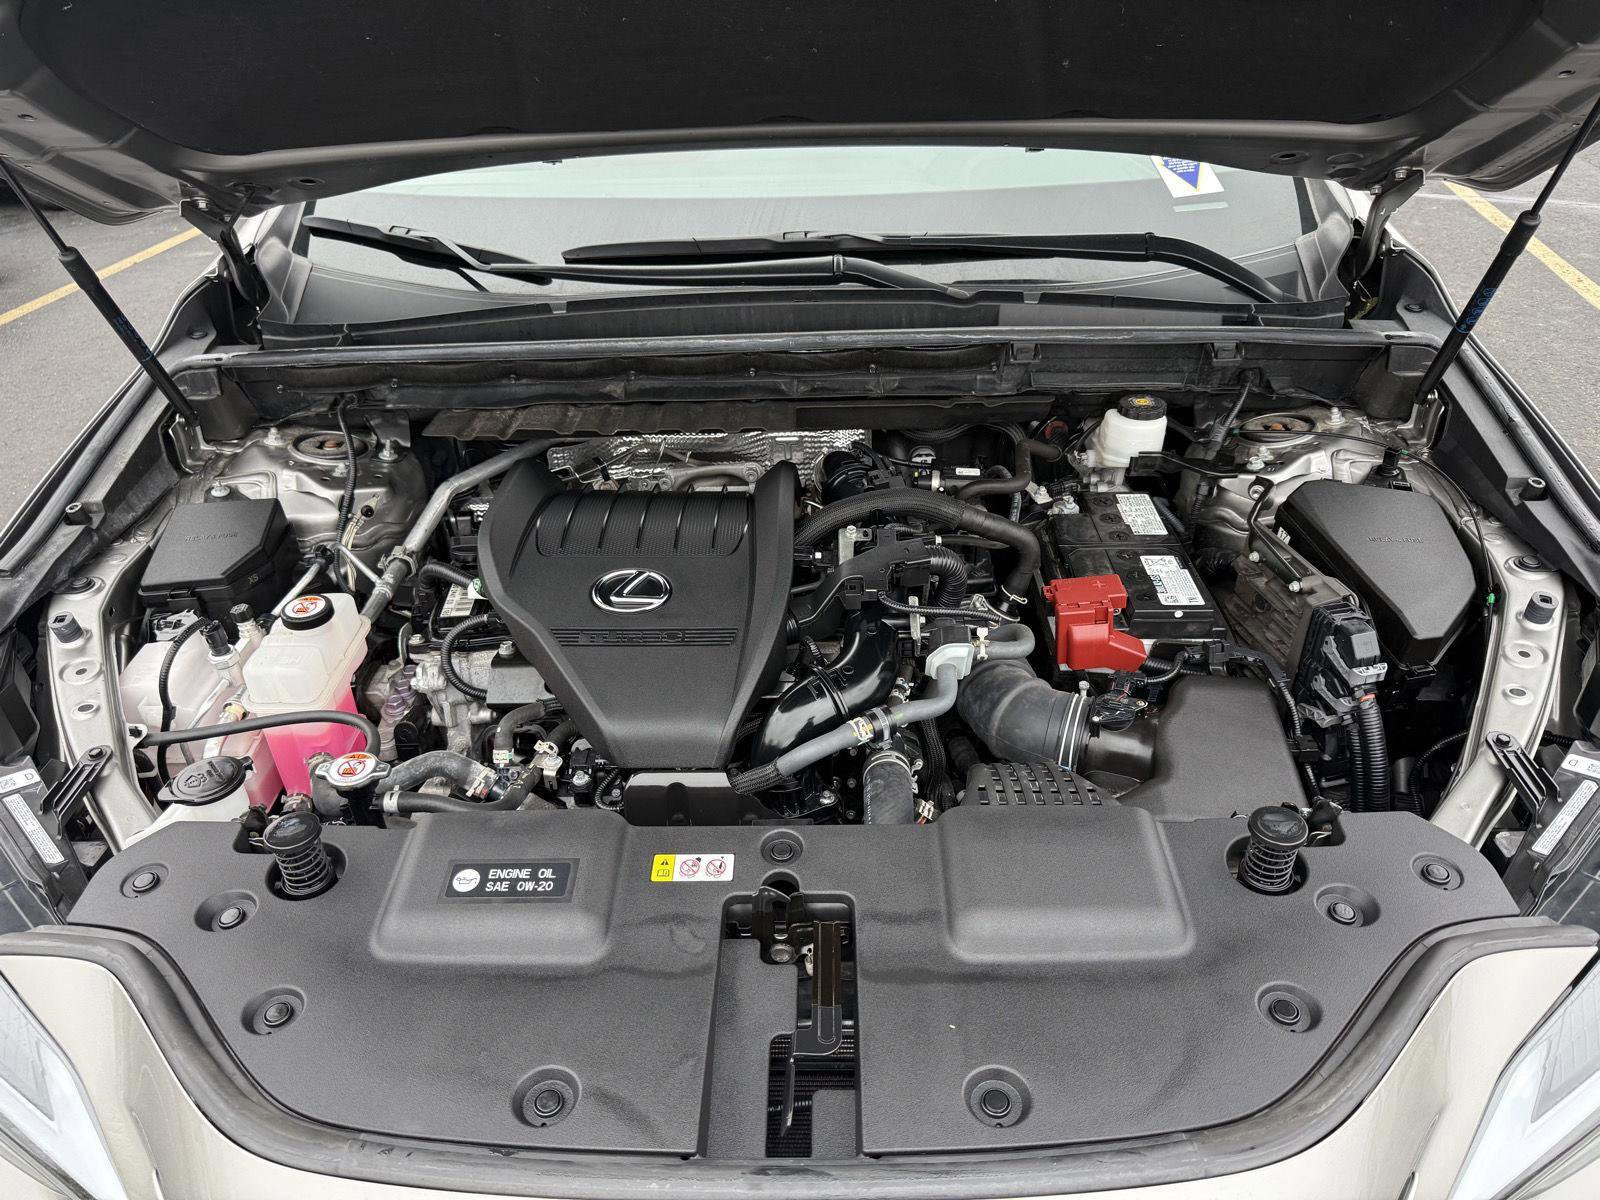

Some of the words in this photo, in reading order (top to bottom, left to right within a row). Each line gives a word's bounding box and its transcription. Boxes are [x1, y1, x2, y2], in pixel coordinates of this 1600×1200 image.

[488, 868, 531, 880] ENGINE
[538, 868, 557, 879] OIL
[485, 881, 510, 892] SAE
[516, 881, 554, 891] 0W-20
